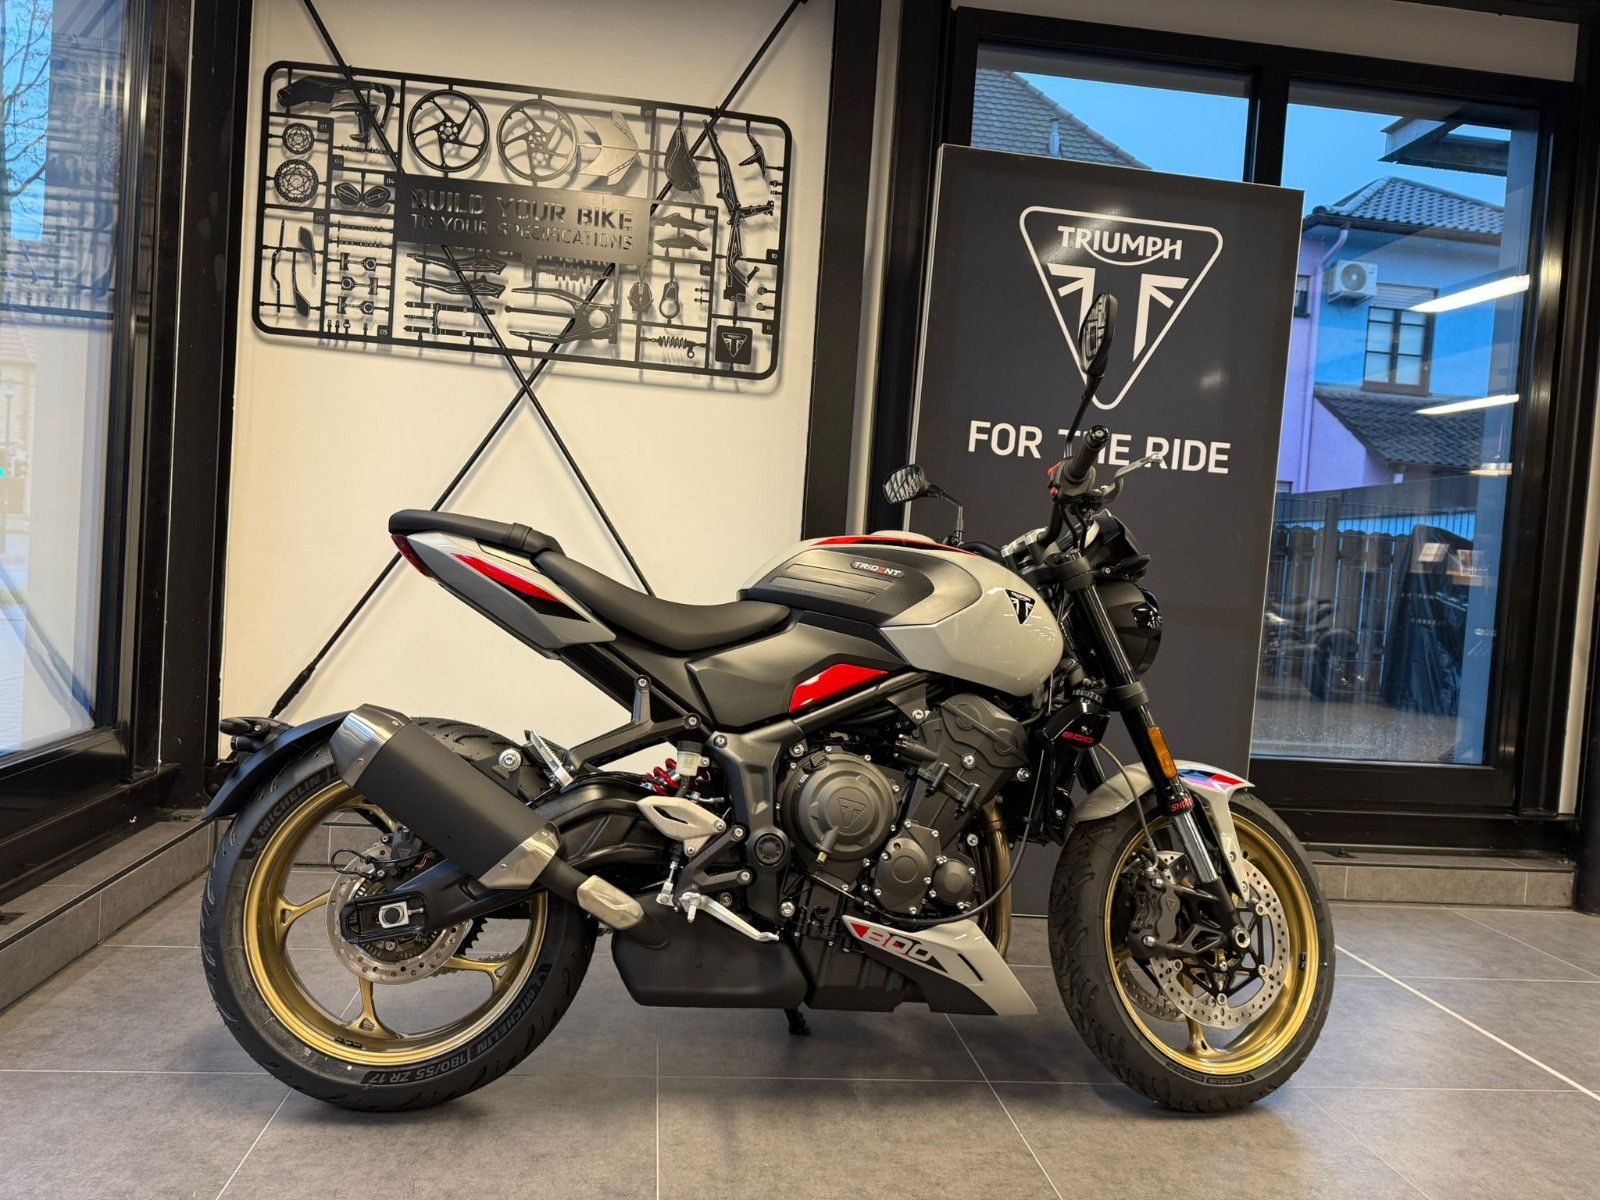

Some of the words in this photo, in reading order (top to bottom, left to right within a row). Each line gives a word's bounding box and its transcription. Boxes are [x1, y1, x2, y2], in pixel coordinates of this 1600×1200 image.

[410, 188, 485, 215] BUILD
[496, 196, 566, 225] YOUR
[576, 205, 634, 231] BIKE
[441, 215, 489, 236] YOUR
[497, 221, 634, 251] SPECIFICATIONS
[1057, 225, 1183, 266] TRIUMPH
[968, 420, 1044, 459] FOR
[1144, 436, 1232, 474] RIDE
[853, 561, 902, 576] TRIDENT
[257, 773, 322, 836] MICHELIN
[866, 926, 933, 962] 800
[475, 985, 538, 1054] MICHELIN
[368, 1072, 387, 1084] 17
[389, 1070, 409, 1084] ZR
[415, 1054, 467, 1080] 180/55
